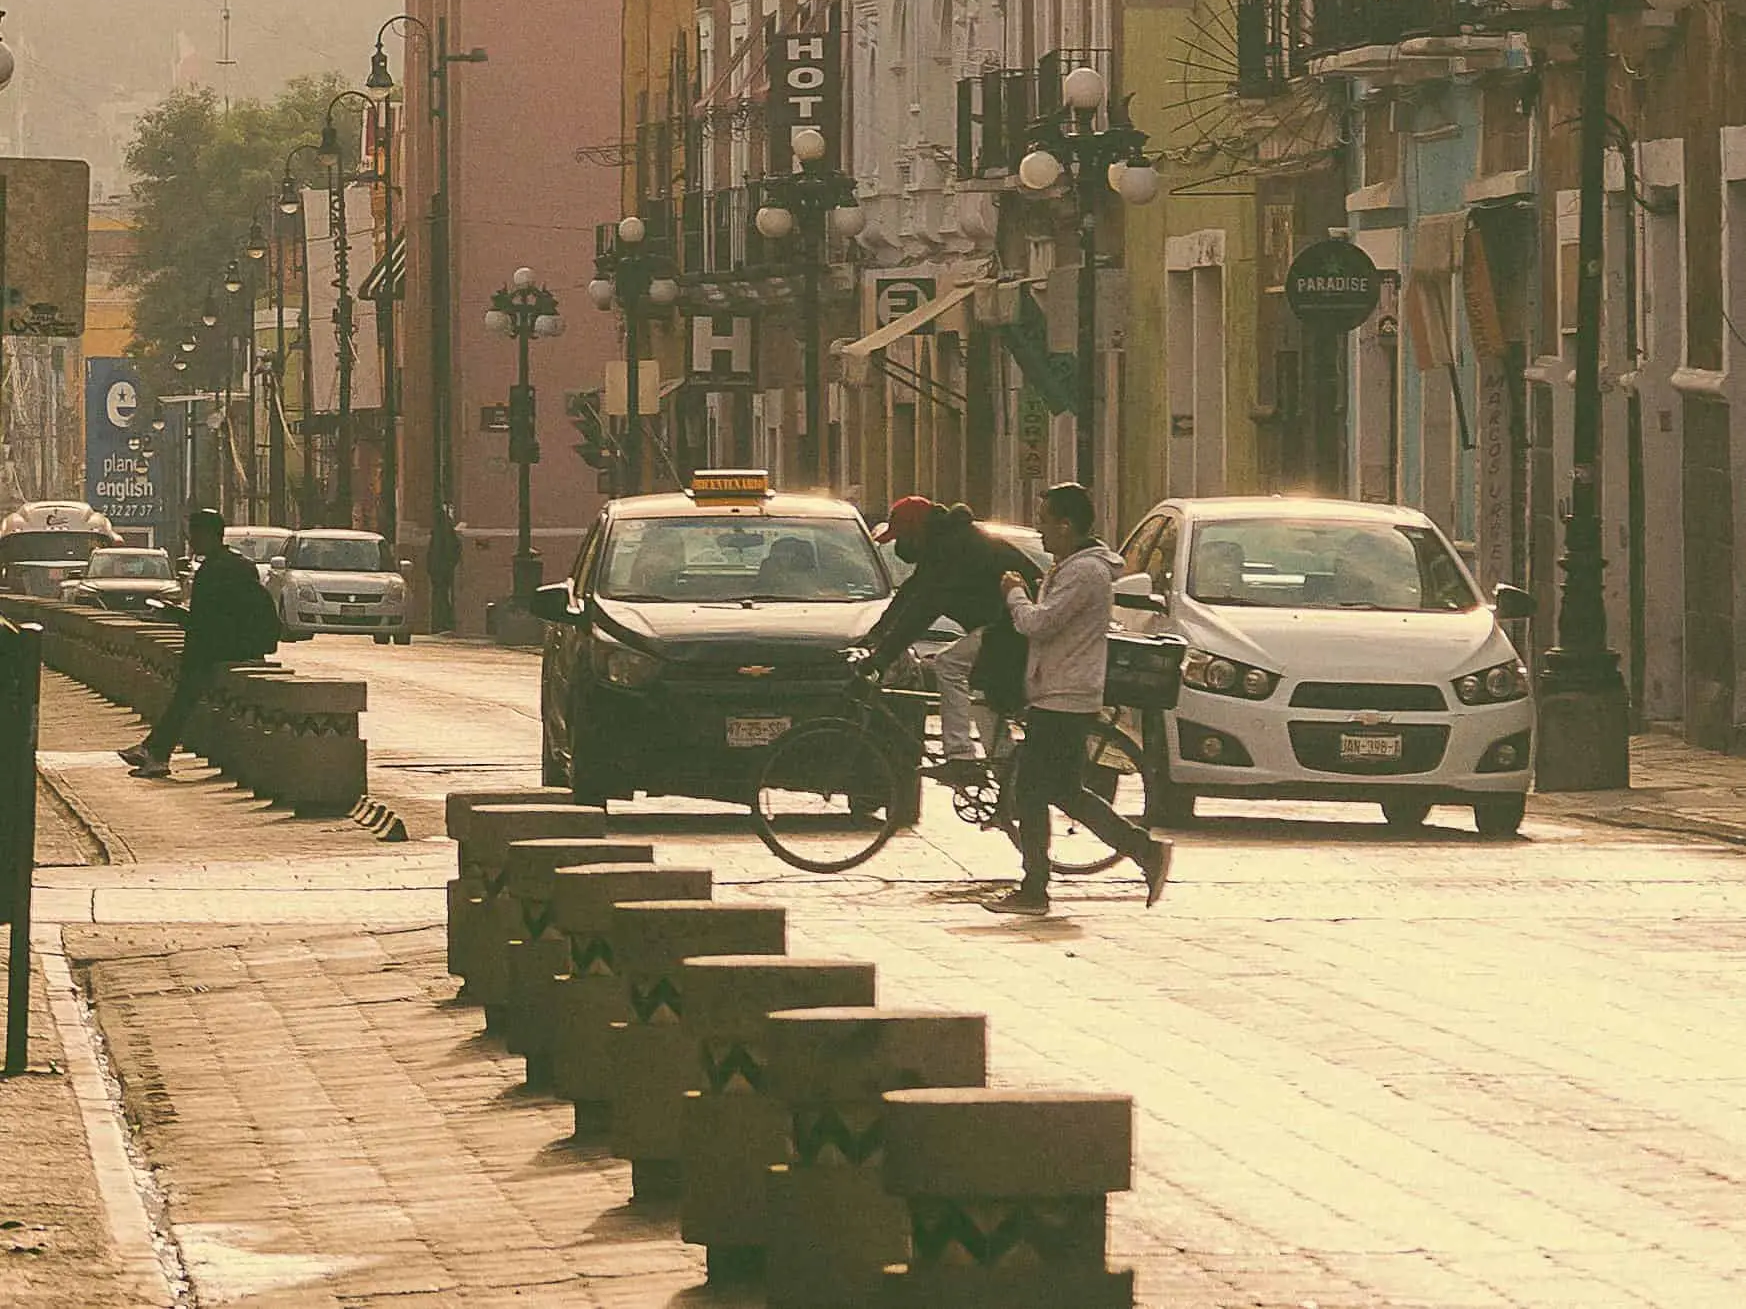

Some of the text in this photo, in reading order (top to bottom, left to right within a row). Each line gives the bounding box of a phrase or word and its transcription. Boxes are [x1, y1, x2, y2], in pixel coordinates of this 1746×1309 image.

[1297, 276, 1368, 292] PARADISE
[693, 316, 751, 372] H
[104, 453, 149, 477] plan
[96, 477, 153, 501] english
